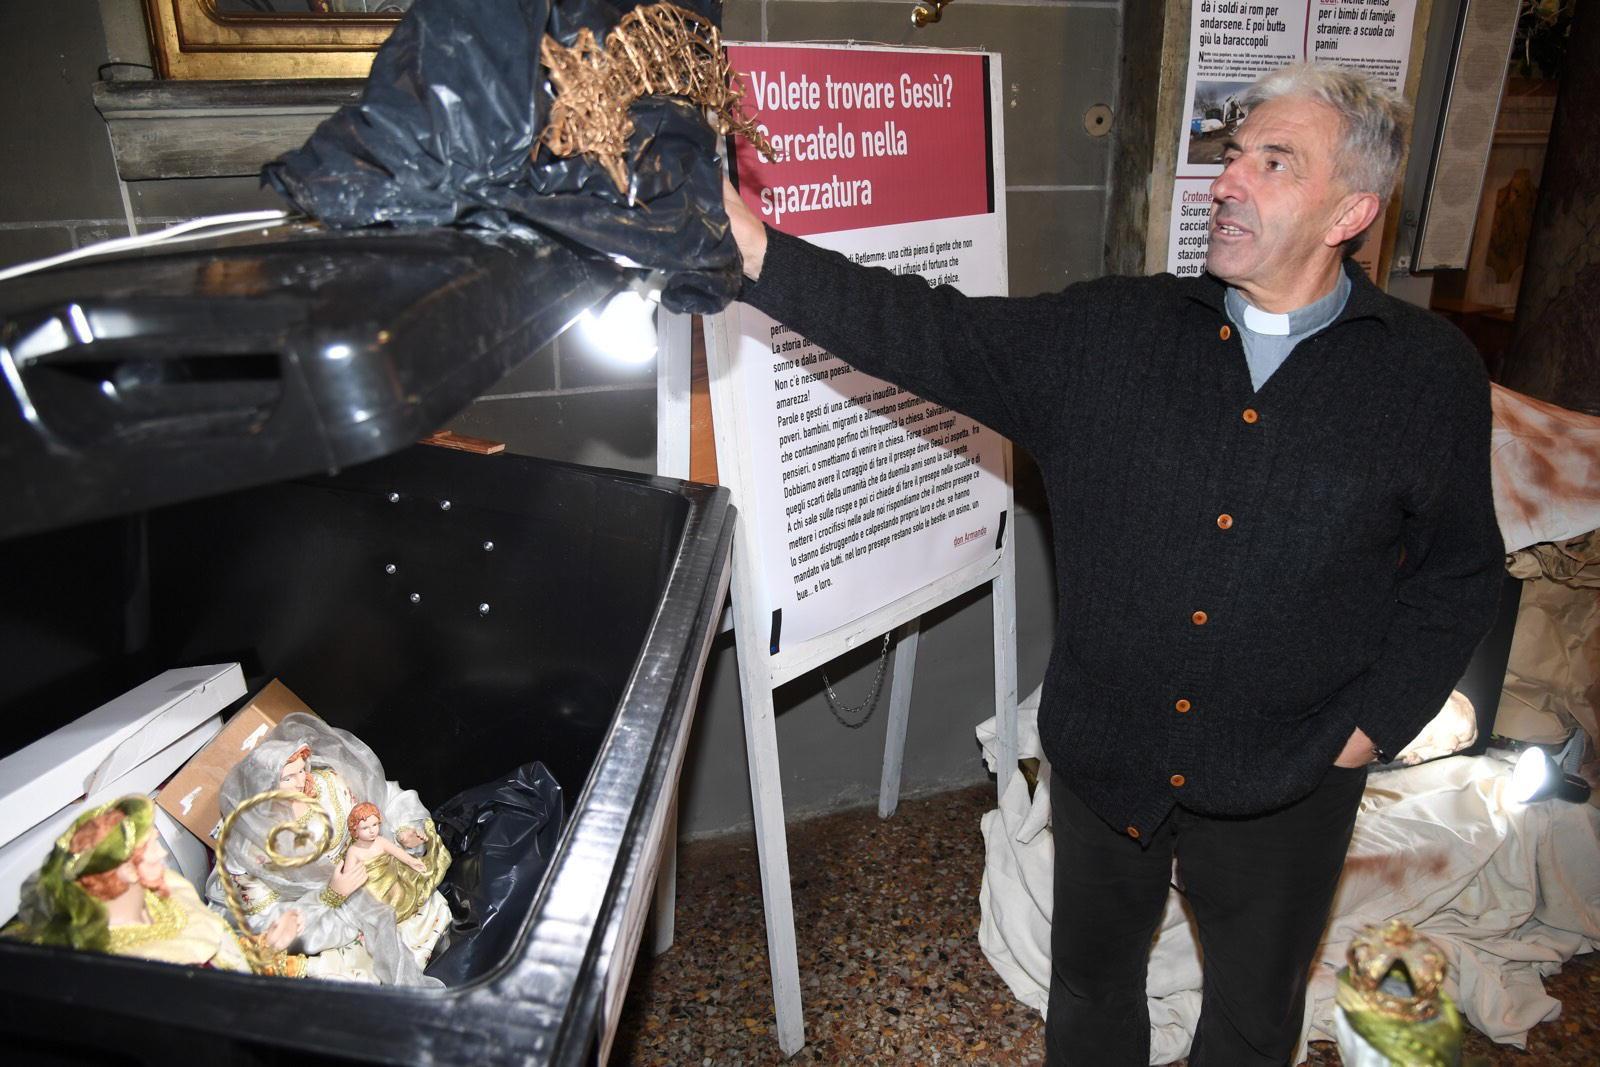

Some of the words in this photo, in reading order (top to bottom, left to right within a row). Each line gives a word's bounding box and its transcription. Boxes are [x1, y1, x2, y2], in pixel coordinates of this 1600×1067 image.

[1201, 1, 1211, 13] dà
[1217, 0, 1239, 14] soldi
[1240, 2, 1247, 14] ai
[1248, 7, 1264, 15] rom
[1265, 7, 1279, 19] per
[1319, 9, 1332, 21] per
[1338, 8, 1359, 20] bimbi
[1360, 9, 1368, 20] di
[1369, 9, 1395, 24] famiglie
[1200, 17, 1243, 30] andarsene.
[1246, 19, 1251, 31] E
[1252, 19, 1265, 33] poi
[1266, 20, 1286, 32] butta
[1317, 23, 1352, 35] straniere:
[1360, 25, 1383, 37] scuola
[1385, 26, 1394, 37] coi
[1200, 32, 1211, 47] giù
[1213, 33, 1221, 45] la
[1223, 34, 1269, 49] baraccopoli
[1315, 38, 1338, 51] panini
[751, 70, 821, 111] Volete
[826, 74, 894, 109] trovare
[900, 73, 953, 108] Gesù?
[756, 121, 856, 164] Cercatelo
[862, 120, 908, 158] nella
[760, 174, 872, 225] spazzatura
[1181, 205, 1210, 216] Sicurez
[888, 250, 899, 260] una
[900, 246, 912, 258] città
[913, 244, 928, 259] piena
[929, 242, 935, 253] di
[936, 240, 951, 255] gente
[952, 239, 961, 251] che
[962, 239, 973, 248] non
[922, 260, 928, 271] di
[928, 258, 948, 270] fortuna
[949, 256, 959, 266] che
[1177, 264, 1197, 276] posto
[772, 342, 780, 354] La
[782, 338, 801, 352] storia
[773, 360, 793, 373] sonno
[801, 353, 817, 366] dalla
[775, 379, 788, 392] Non
[790, 375, 800, 388] c'è
[801, 370, 828, 384] nessuna
[776, 390, 811, 409] amarezza!
[777, 412, 799, 427] Parole
[806, 404, 822, 422] gesti
[831, 402, 842, 413] una
[844, 394, 872, 409] cattiveria
[873, 386, 896, 400] inaudita
[833, 413, 858, 430] migranti
[781, 452, 793, 463] che
[795, 440, 835, 459] contaminano
[837, 432, 859, 448] perfino
[860, 426, 869, 438] chi
[870, 418, 897, 437] frequenta
[818, 453, 850, 469] smettiamo
[859, 443, 877, 456] venire
[906, 428, 921, 441] Forse
[923, 423, 938, 435] siamo
[784, 480, 816, 499] Dobbiamo
[818, 474, 835, 486] avere
[842, 462, 868, 479] coraggio
[876, 456, 888, 468] fare
[894, 448, 916, 463] presepe
[917, 442, 930, 453] dove
[786, 499, 806, 518] quegli
[807, 492, 825, 508] scarti
[827, 488, 841, 501] della
[843, 480, 867, 495] umanità
[868, 475, 879, 488] che
[888, 465, 910, 480] duemila
[911, 458, 923, 471] anni
[924, 456, 936, 468] sono
[943, 450, 952, 461] sua
[794, 517, 803, 531] chi
[805, 514, 818, 527] sale
[819, 508, 834, 521] sulle
[835, 502, 853, 515] ruspe
[859, 495, 868, 509] poi
[876, 486, 895, 500] chiede
[902, 478, 914, 490] fare
[918, 470, 940, 488] presepe
[941, 464, 954, 476] nelle
[954, 458, 971, 471] scuole
[789, 533, 813, 551] mettere
[818, 518, 846, 539] crocifissi
[847, 514, 862, 528] nelle
[863, 509, 875, 522] aule
[877, 503, 885, 516] noi
[886, 493, 920, 511] rispondiamo
[921, 488, 931, 499] che
[936, 480, 951, 492] nostro
[952, 473, 972, 489] presepe
[798, 548, 819, 564] stanno
[820, 531, 860, 555] distruggendo
[865, 515, 899, 537] calpestando
[900, 508, 919, 525] proprio
[920, 503, 931, 515] loro
[954, 489, 970, 500] hanno
[953, 535, 963, 547] don
[965, 526, 988, 540] Armando
[794, 565, 820, 584] mandato
[820, 562, 830, 572] via
[845, 549, 854, 561] nel
[855, 545, 867, 557] loro
[868, 536, 890, 554] presepe
[891, 527, 912, 542] restano
[912, 521, 924, 533] solo
